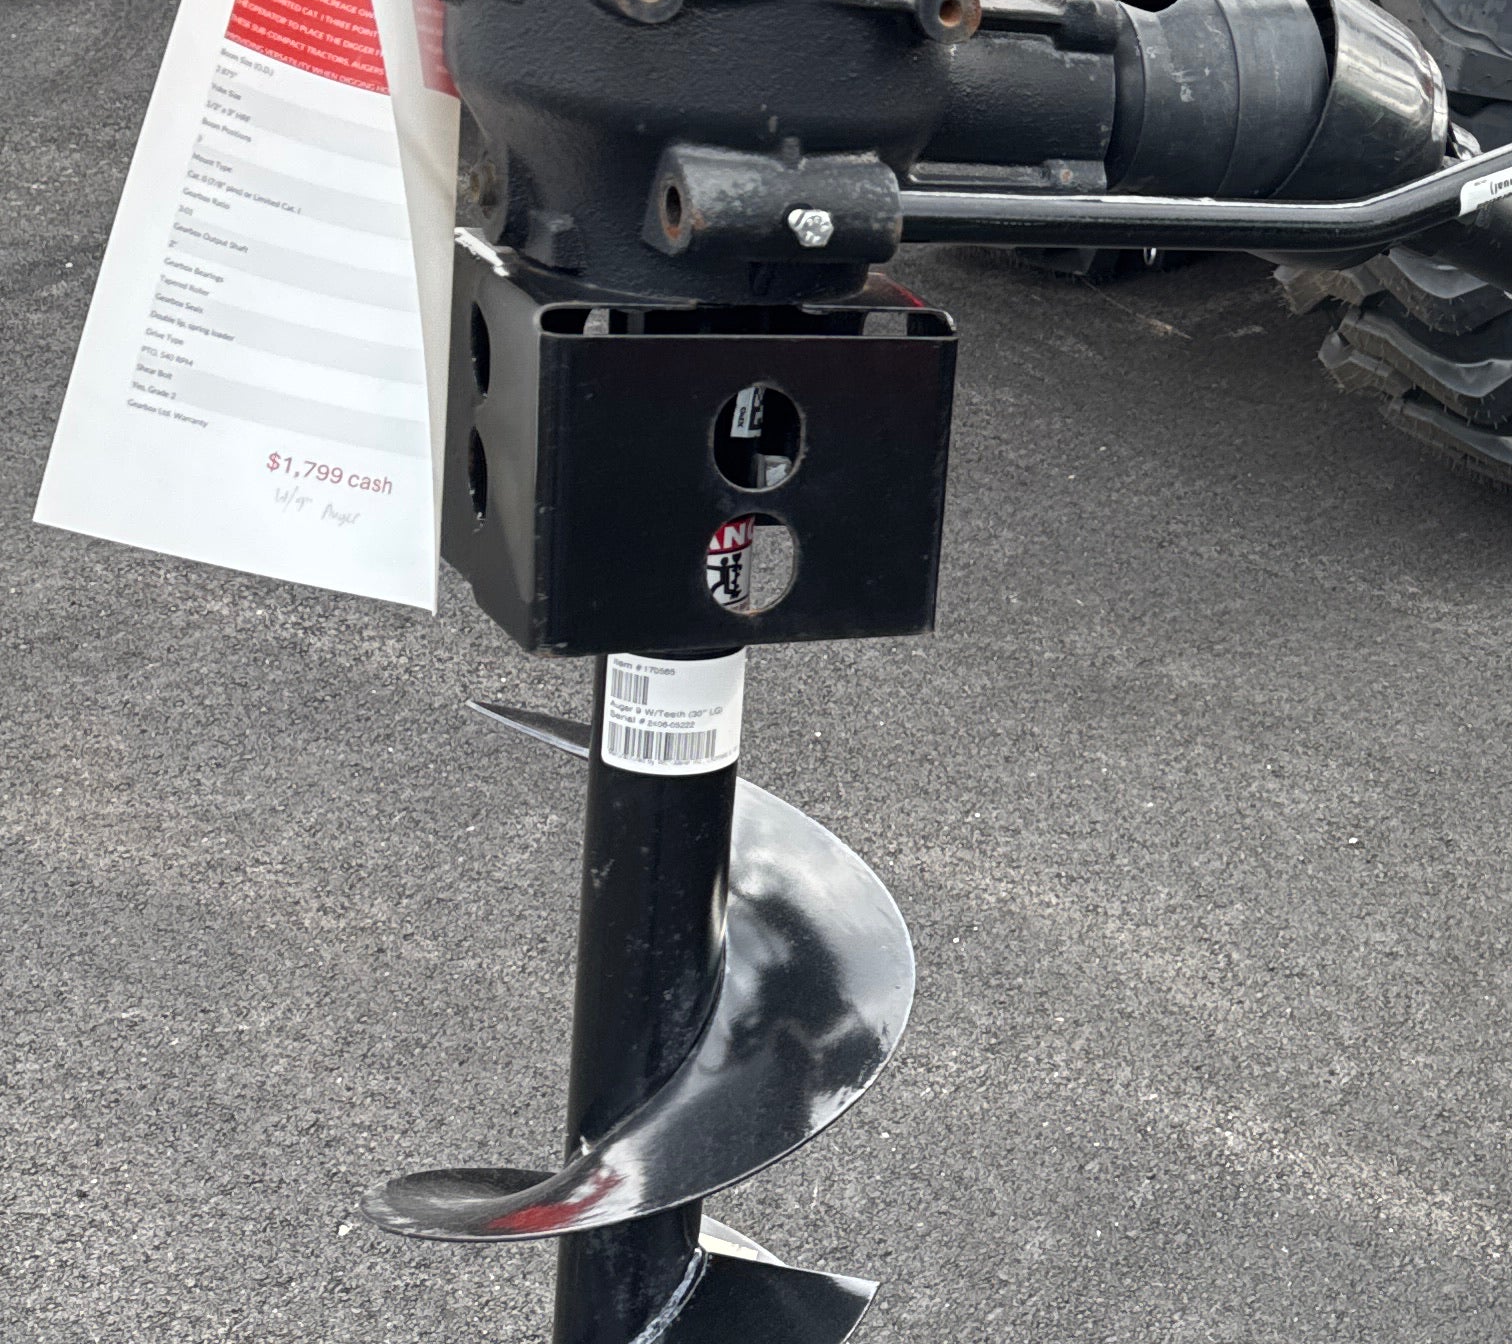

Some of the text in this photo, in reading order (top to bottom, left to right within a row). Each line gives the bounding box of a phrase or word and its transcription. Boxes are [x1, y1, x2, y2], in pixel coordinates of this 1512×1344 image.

[300, 24, 324, 40] PLACE
[343, 38, 375, 54] DIGGER
[173, 222, 249, 254] Gearbox Output Shaft
[164, 257, 224, 283] Gearbox Bearings
[155, 292, 184, 308] Gearbox
[173, 412, 208, 429] Warranty
[266, 451, 393, 495] $1,799 cash
[613, 658, 633, 670] Item
[610, 700, 633, 712] Auger
[645, 708, 685, 718] W/Teeth
[610, 709, 636, 724] Serial
